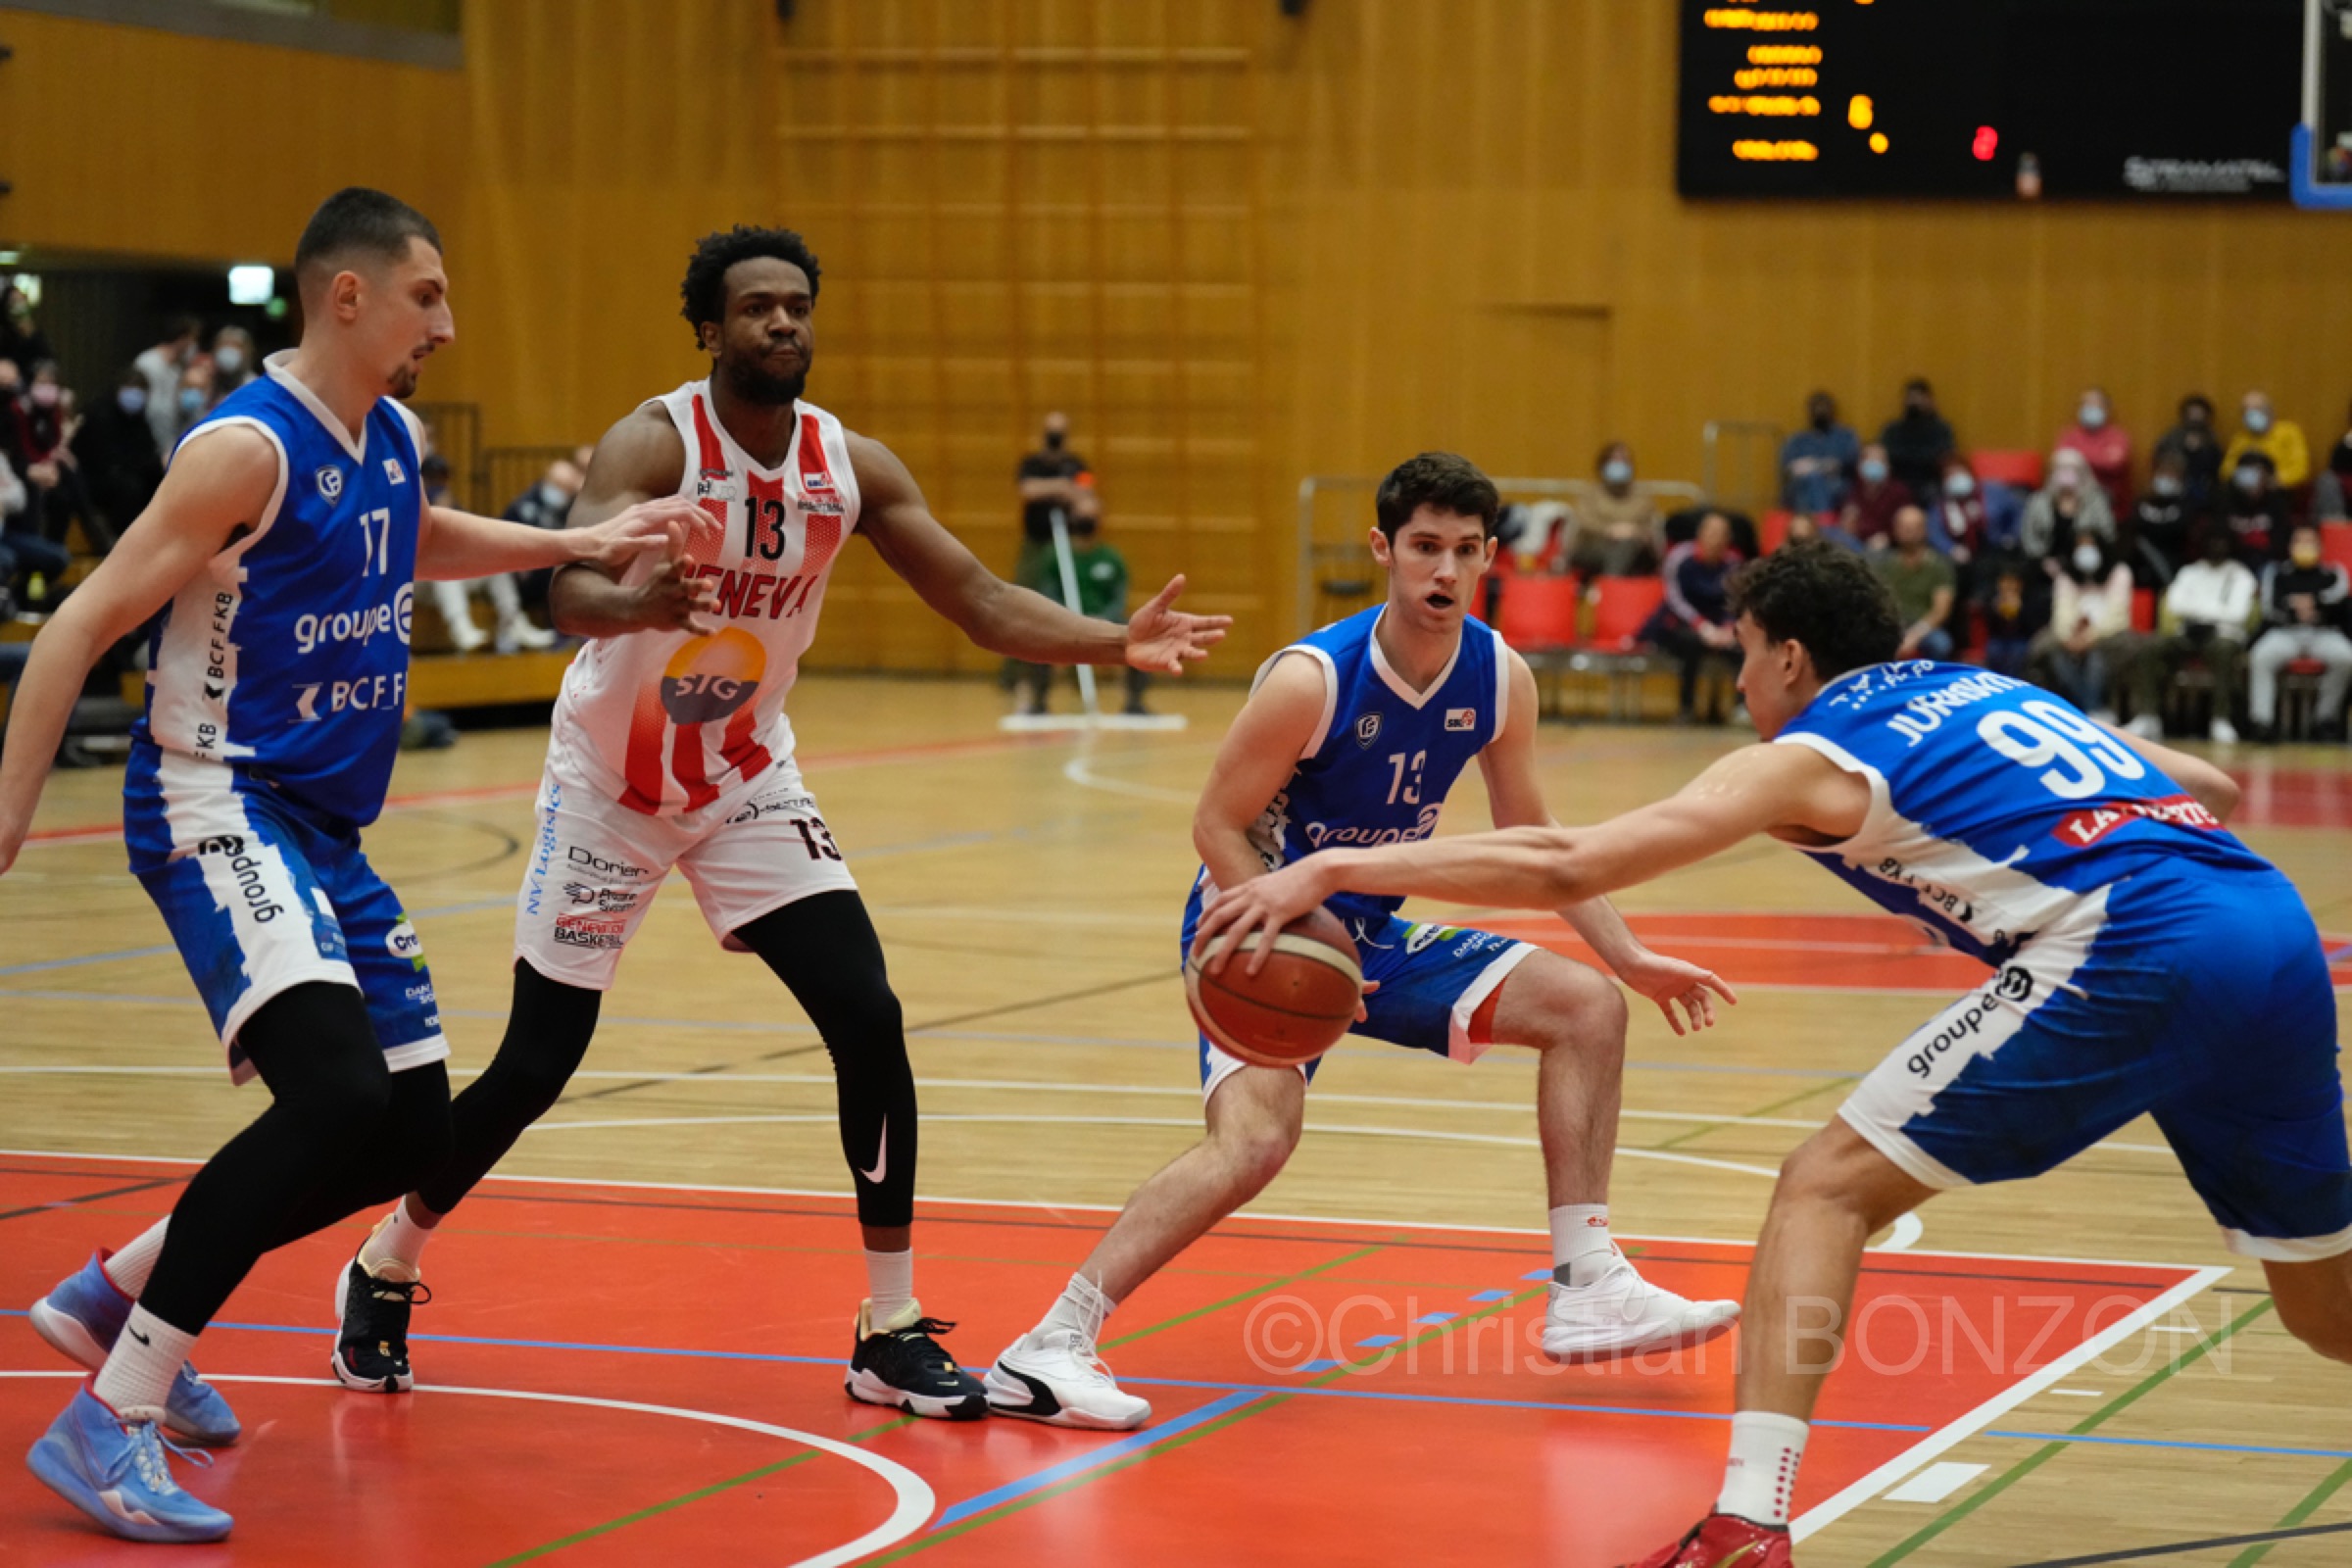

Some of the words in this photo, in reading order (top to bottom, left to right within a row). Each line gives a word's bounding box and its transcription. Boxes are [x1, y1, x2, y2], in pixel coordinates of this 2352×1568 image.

[359, 508, 390, 577] 17
[744, 496, 786, 561] 13
[295, 604, 391, 656] groupe
[331, 676, 386, 712] BCF
[675, 673, 738, 701] SIG
[1977, 700, 2146, 800] 99
[1386, 750, 1427, 806] 13
[567, 846, 650, 877] Dorier
[789, 816, 842, 861] 13
[1907, 994, 1999, 1079] groupe
